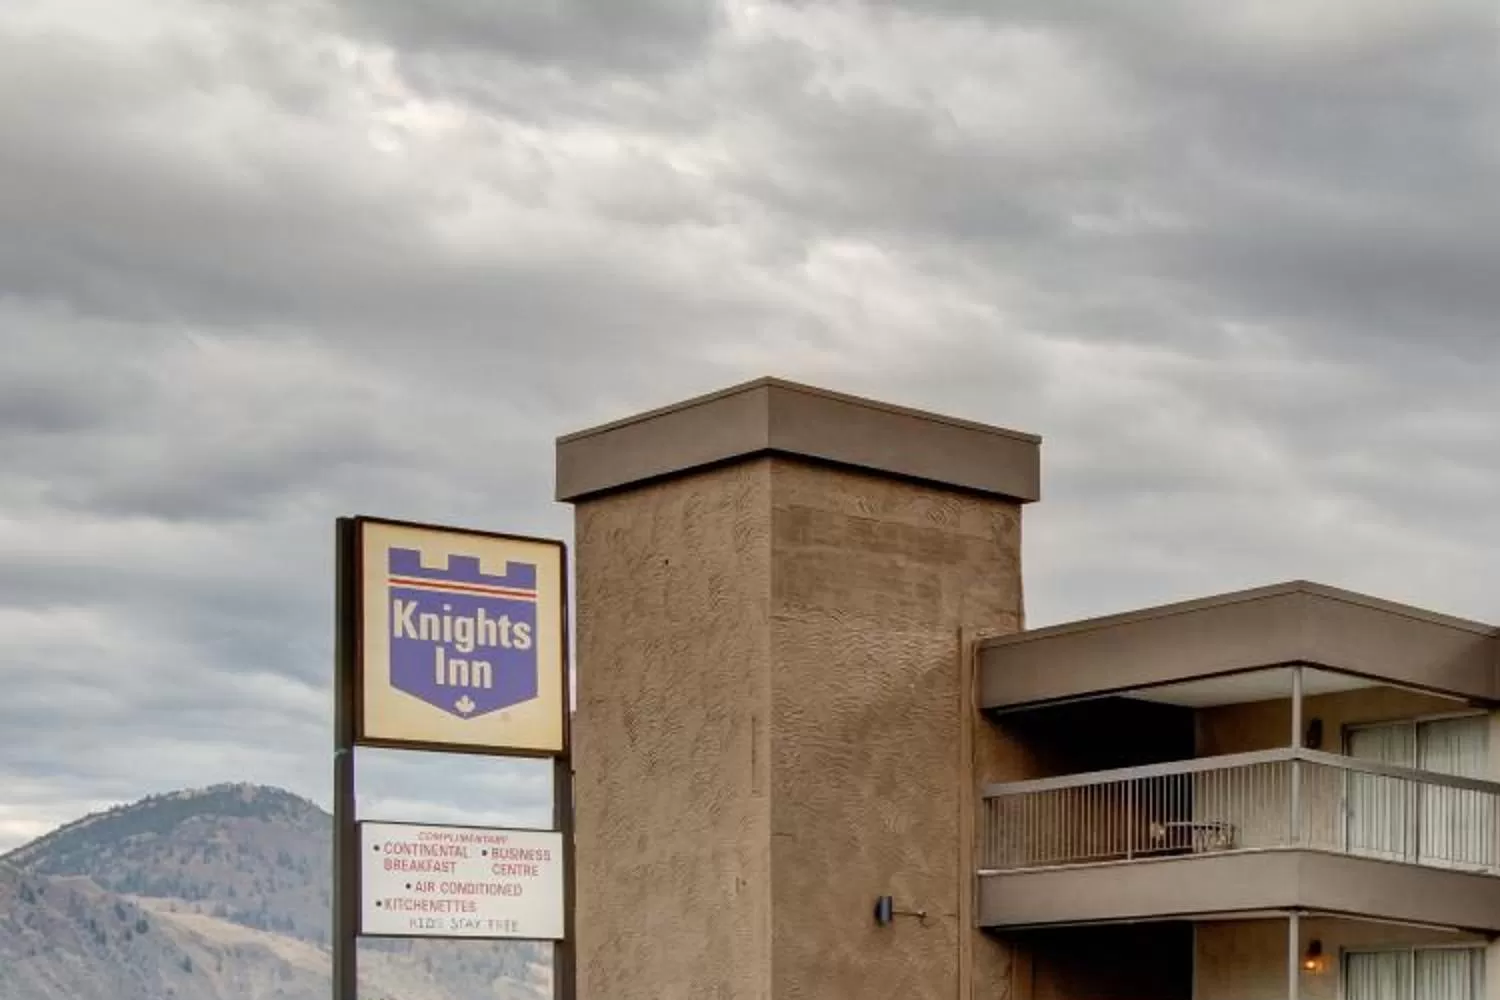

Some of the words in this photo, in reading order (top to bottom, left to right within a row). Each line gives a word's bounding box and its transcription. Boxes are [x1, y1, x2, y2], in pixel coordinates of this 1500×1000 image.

[393, 600, 532, 653] Knights
[435, 646, 493, 689] Inn
[383, 841, 470, 859] CONTINENTAL
[491, 847, 551, 861] BUSINESS
[383, 859, 457, 875] BREAKFAST
[491, 863, 539, 876] CENTRE
[415, 881, 435, 893] AIR
[440, 882, 523, 896] CONDITIONED
[384, 899, 477, 913] KITCHENETTES
